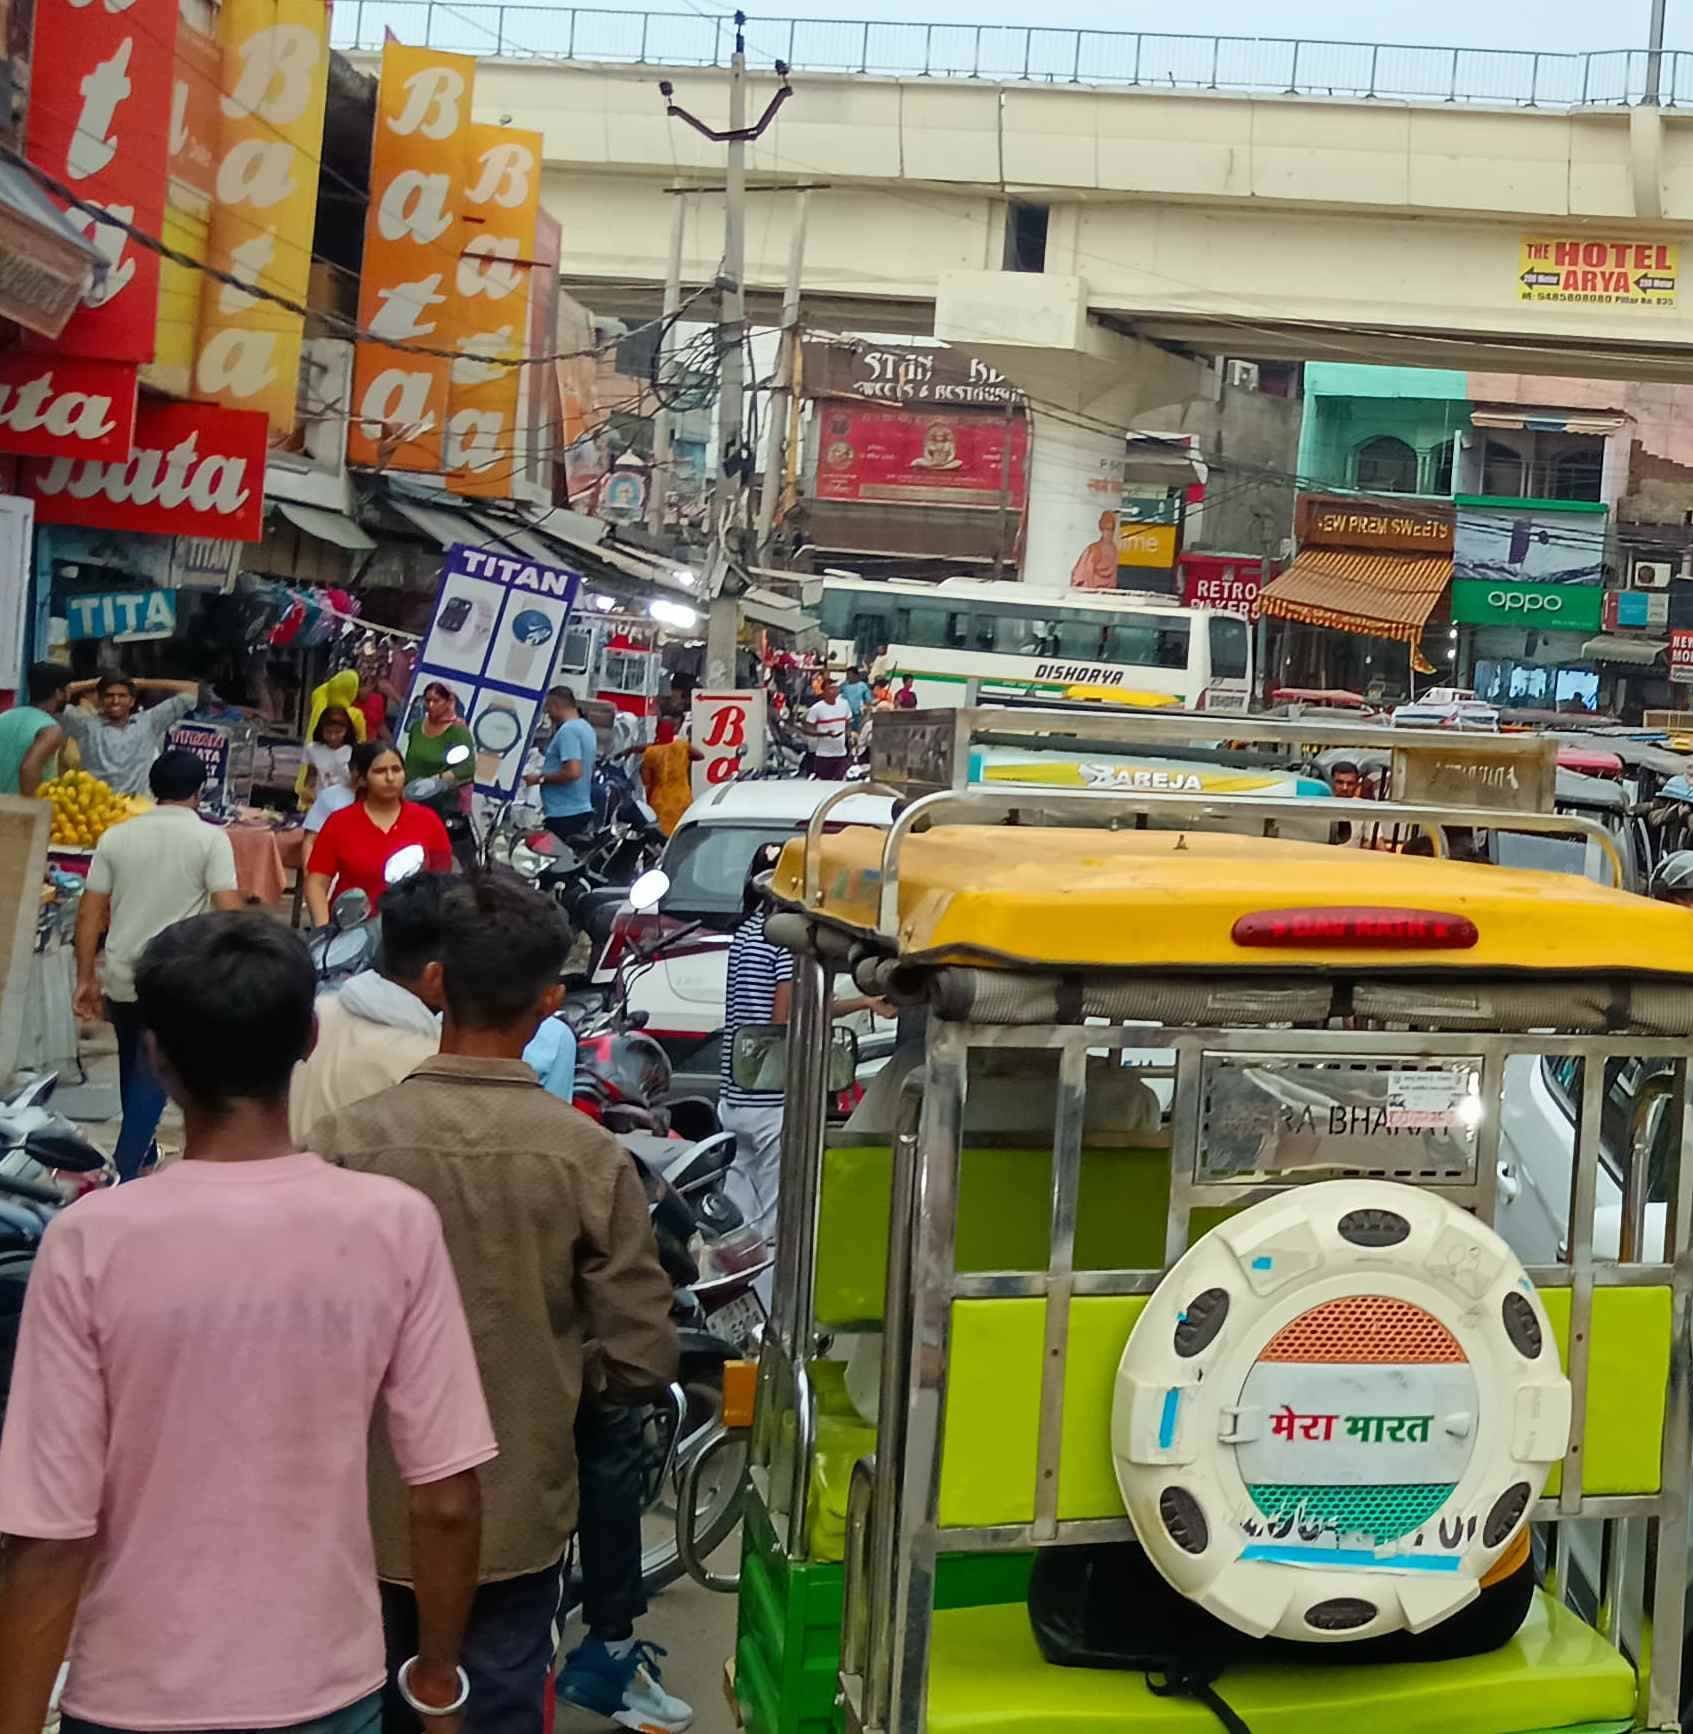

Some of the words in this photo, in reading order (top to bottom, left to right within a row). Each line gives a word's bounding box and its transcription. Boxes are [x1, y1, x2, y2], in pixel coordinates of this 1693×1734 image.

[197, 23, 321, 397] Bata
[360, 66, 465, 442] Bata
[1527, 243, 1550, 260] THE
[1555, 242, 1672, 270] HOTEL
[1562, 270, 1631, 293] ARYA
[446, 144, 534, 474] Bata
[0, 371, 117, 440] ta
[1318, 514, 1345, 533] EW
[1349, 516, 1388, 535] PREM
[1391, 516, 1448, 539] SWEETS
[462, 550, 569, 597] TITAN
[1197, 580, 1257, 600] RETRO
[1488, 590, 1562, 612] oppo
[1268, 1404, 1341, 1442] मेरा
[1344, 1414, 1435, 1443] भारत
